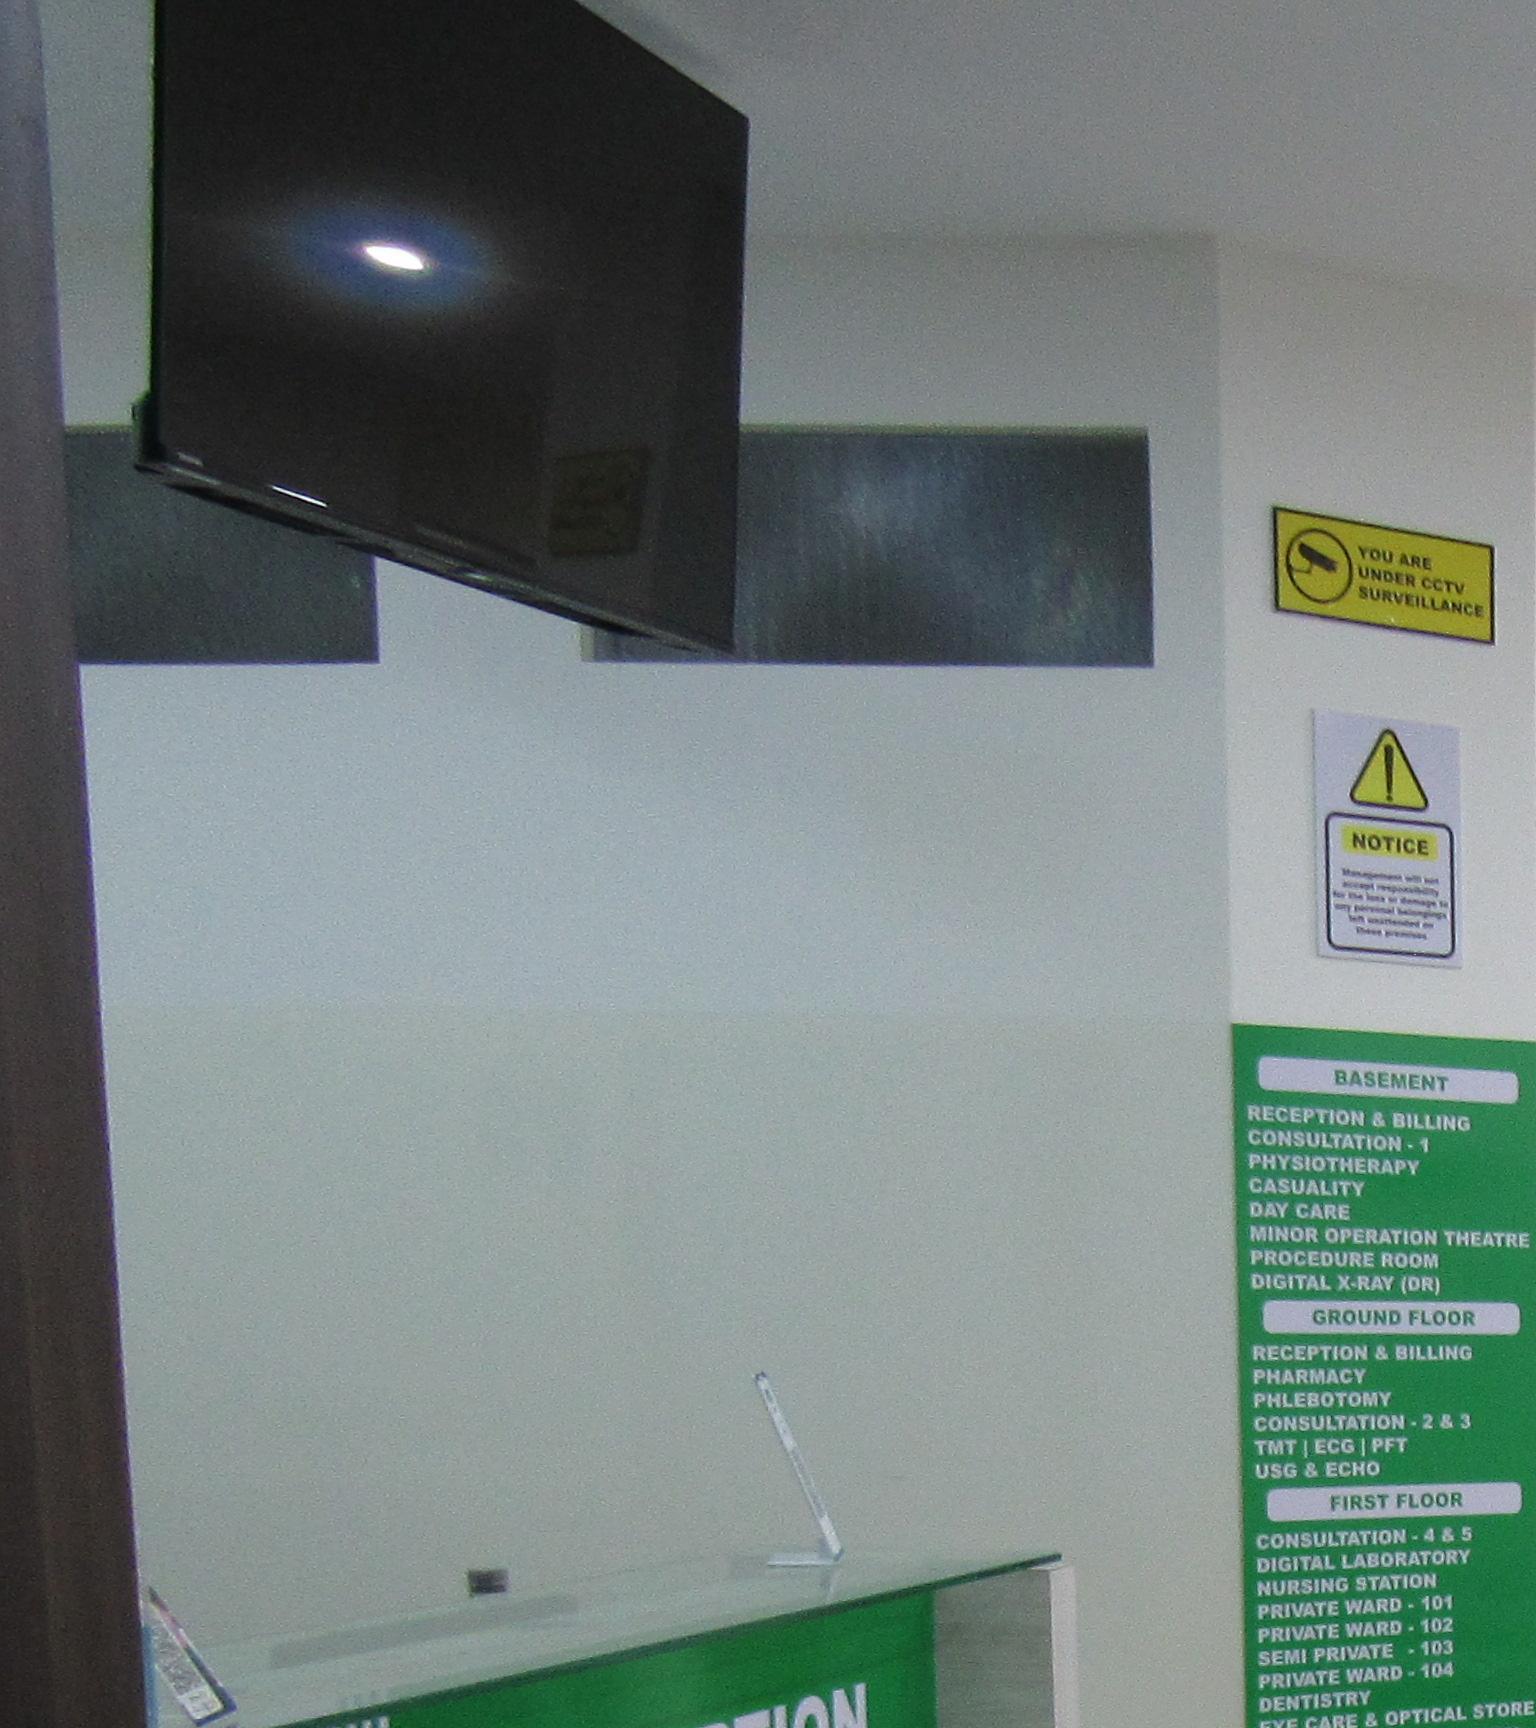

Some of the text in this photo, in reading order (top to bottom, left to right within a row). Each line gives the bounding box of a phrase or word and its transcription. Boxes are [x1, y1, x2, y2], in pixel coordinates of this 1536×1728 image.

[1358, 546, 1431, 570] YOU ARE
[1358, 567, 1464, 595] UNDER CCTV
[1359, 586, 1484, 618] SURVEILLANCE
[1352, 832, 1429, 856] NOTICE
[1334, 1070, 1448, 1091] BASEMENT
[1248, 1106, 1470, 1132] RECEPTION & BILLING
[1248, 1131, 1429, 1152] CONSULTATION 1
[1249, 1155, 1420, 1176] PHYSIOTHERAPY
[1250, 1179, 1365, 1197] CASUALITY
[1250, 1203, 1350, 1221] DAY CARE
[1250, 1226, 1529, 1248] MINOR OPERATION THEATRE
[1251, 1250, 1438, 1268] PROCEDURE ROOM
[1251, 1273, 1440, 1294] DIGITAL X-RAY (DR)
[1313, 1309, 1475, 1327] GROUND FLOOR
[1253, 1345, 1472, 1361] RECEPTION & BILLING
[1254, 1368, 1366, 1384] PHARMACY
[1254, 1392, 1391, 1408] PHLEBOTOMY
[1254, 1413, 1471, 1431] CONSULTATION 2 & 3
[1255, 1437, 1407, 1455] TMT ECG PFT
[1255, 1461, 1379, 1478] USG & ECHO
[1330, 1491, 1462, 1511] FIRST FLOOR
[1257, 1527, 1472, 1549] CONSULTATION 4 & 5
[1257, 1549, 1470, 1573] DIGITAL LABORATORY
[1257, 1574, 1436, 1596] NURSING STATION
[1258, 1596, 1453, 1619] PRIVATE WARD 101
[1258, 1618, 1453, 1643] PRIVATE WARD 102
[1259, 1641, 1453, 1666] SEMI PRIVATE 103
[1259, 1663, 1454, 1689] PRIVATE WARD 104
[1259, 1691, 1371, 1713] DENTISTRY
[1365, 1713, 1377, 1728] &
[1386, 1707, 1467, 1727] OPTICAL
[1473, 1701, 1535, 1719] STORE
